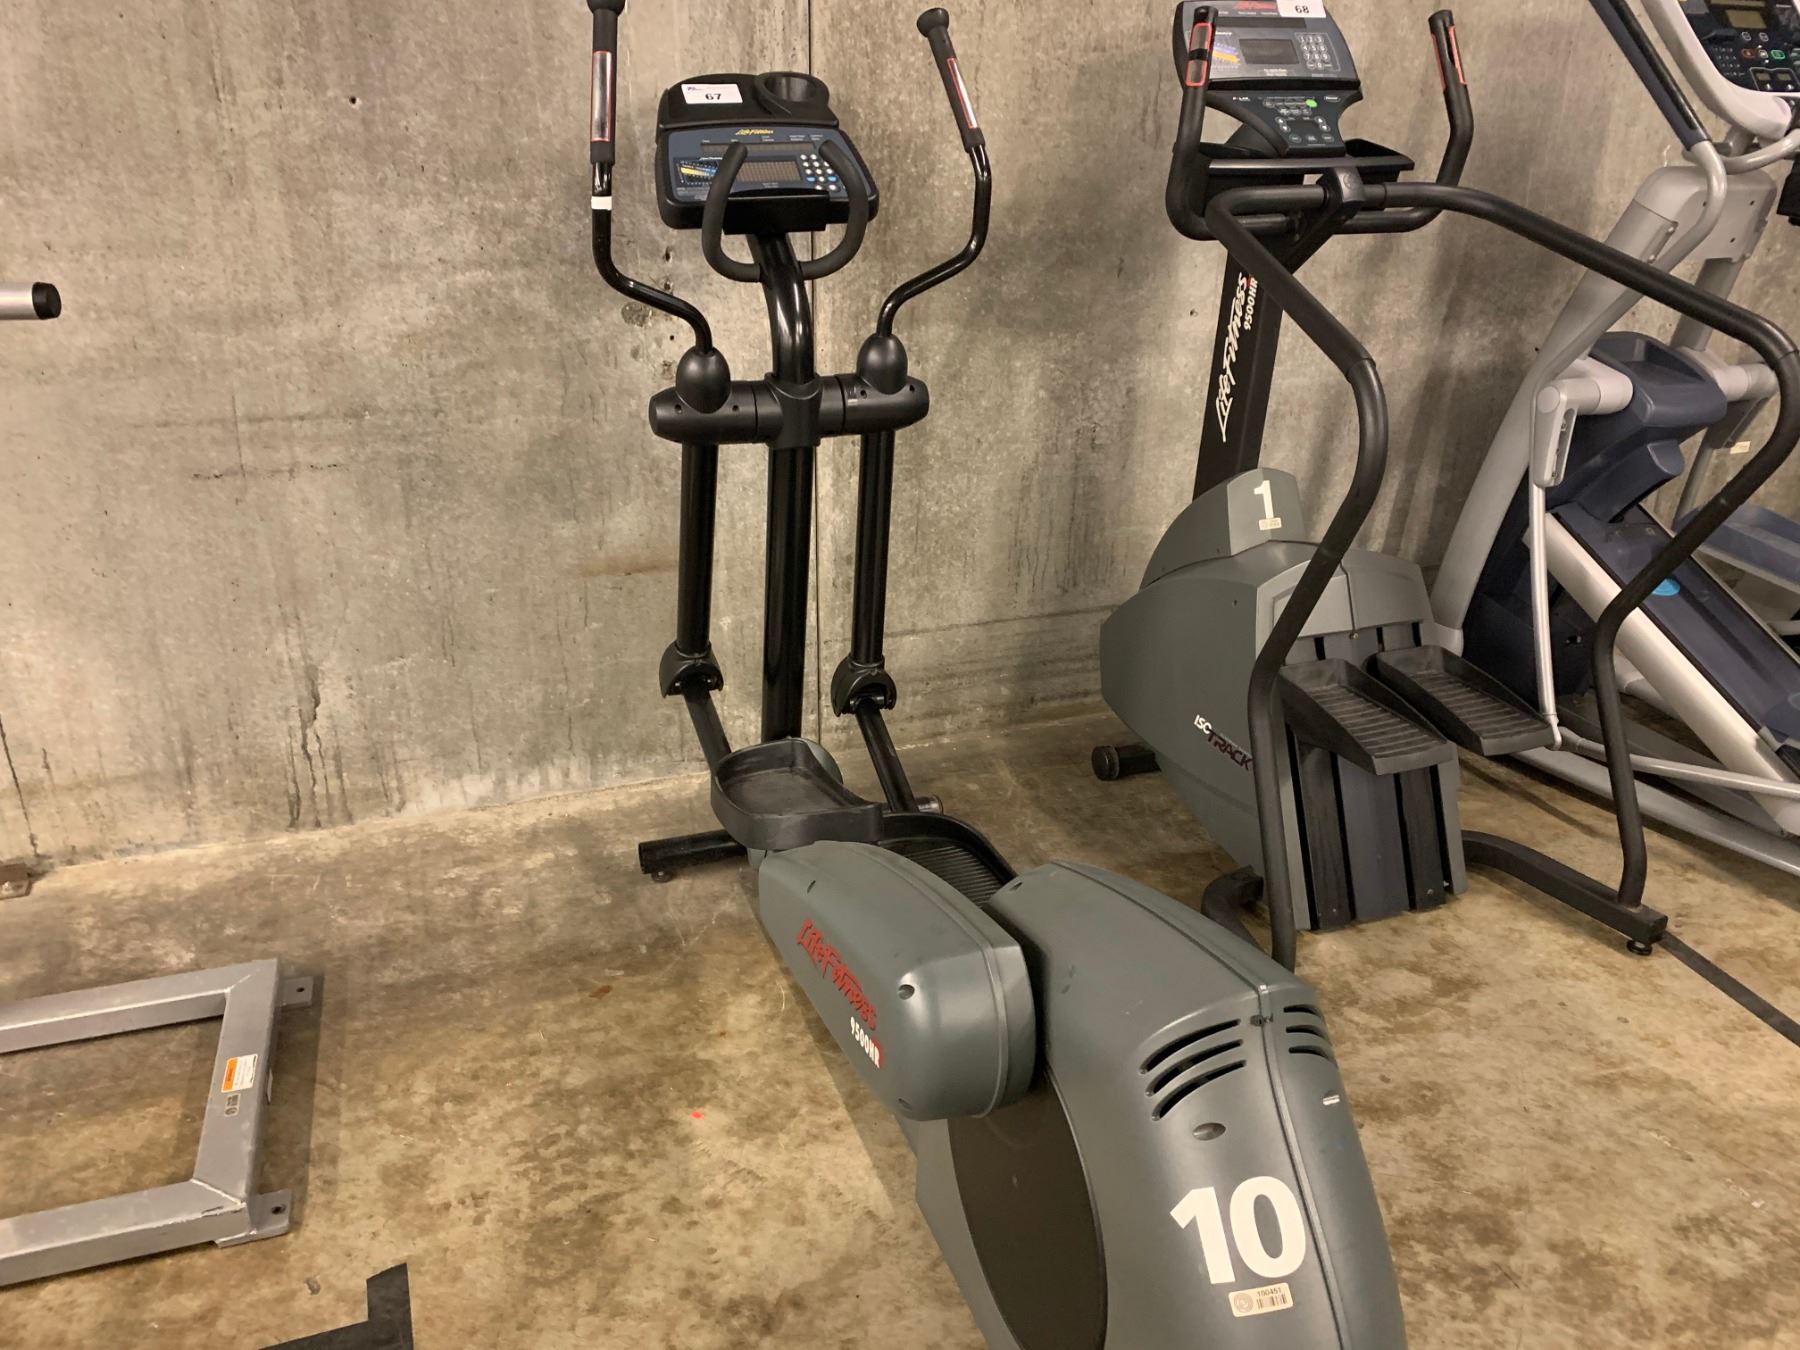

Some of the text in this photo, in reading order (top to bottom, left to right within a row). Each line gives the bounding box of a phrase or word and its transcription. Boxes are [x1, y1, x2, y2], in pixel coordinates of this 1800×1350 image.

[1294, 5, 1310, 14] 68
[705, 93, 722, 101] 67
[1243, 276, 1258, 331] 9500HR
[1253, 479, 1275, 519] 1
[850, 1016, 881, 1069] 9500HR
[1169, 1175, 1307, 1285] 10
